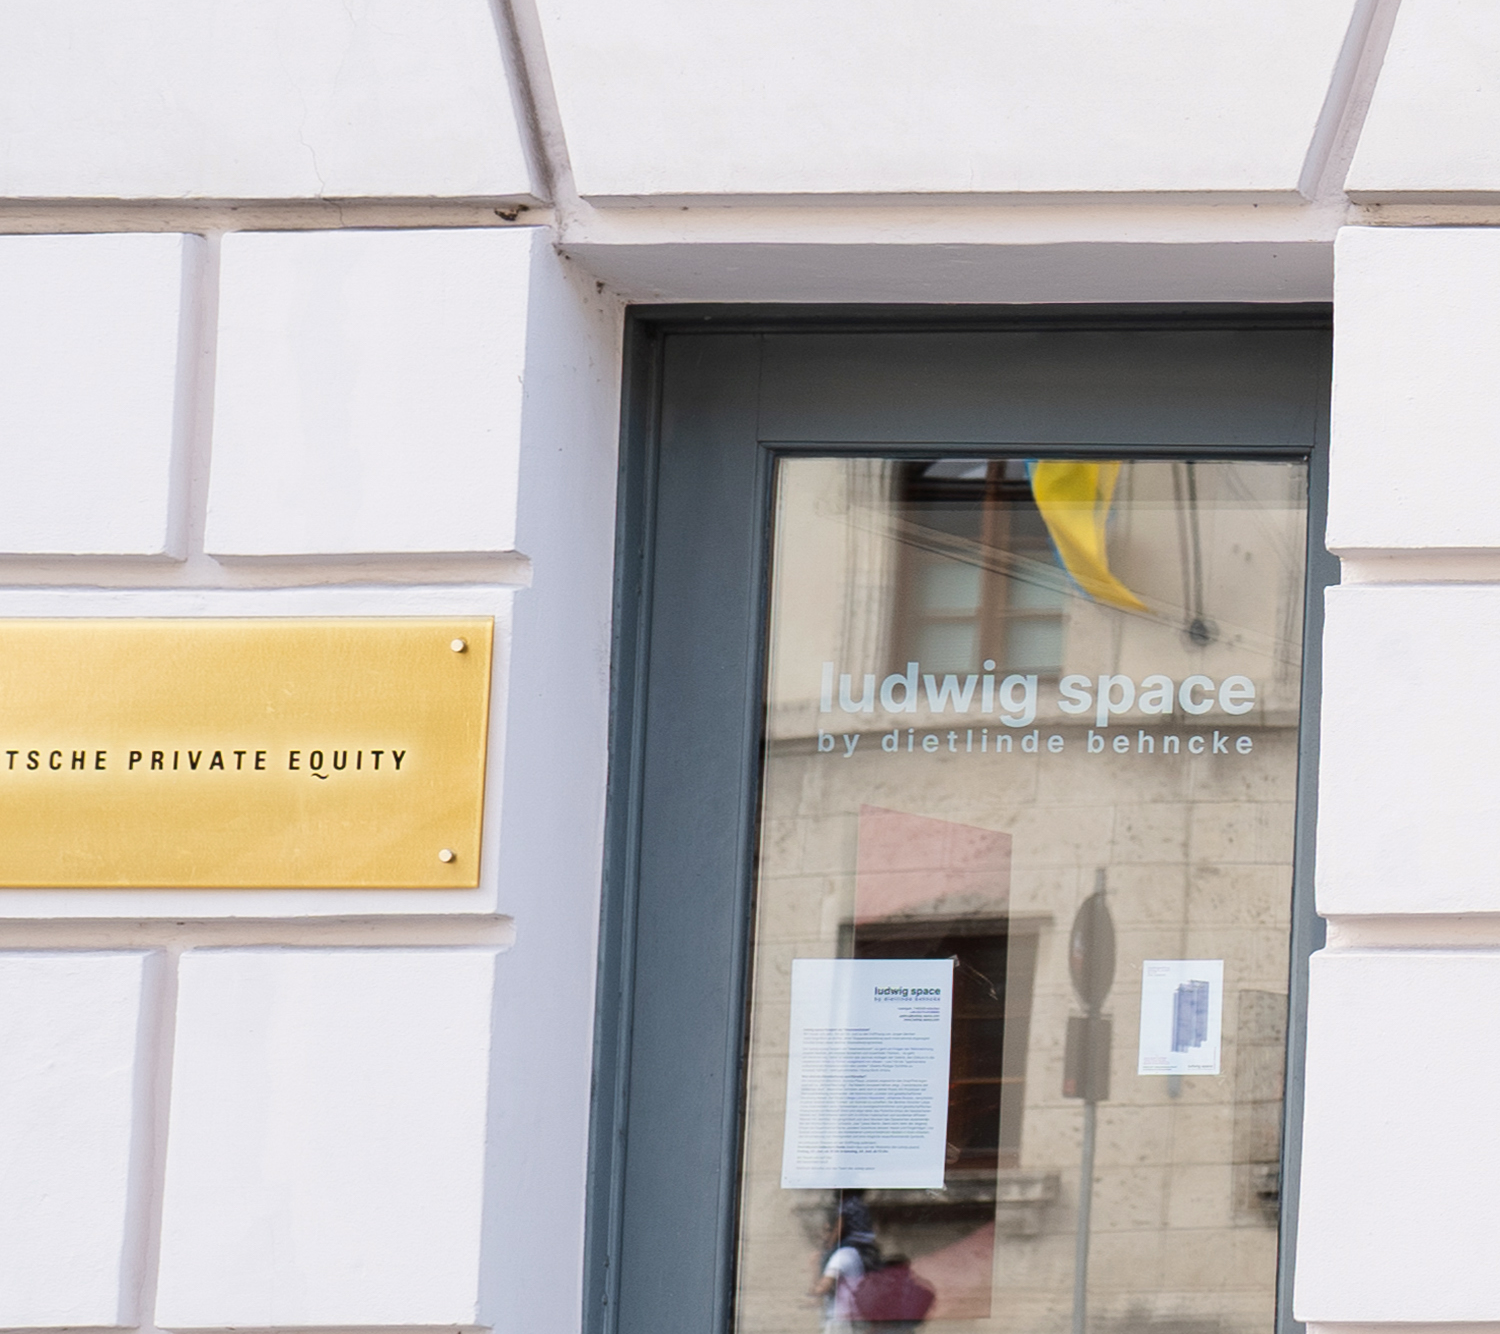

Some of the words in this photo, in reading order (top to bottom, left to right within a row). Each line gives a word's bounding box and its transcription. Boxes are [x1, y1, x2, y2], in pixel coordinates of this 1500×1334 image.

[819, 659, 1039, 728] ludwig
[1057, 673, 1256, 728] space
[816, 729, 861, 758] by
[881, 728, 1066, 754] dietlinde
[1087, 729, 1255, 755] behncke
[128, 750, 268, 771] PRIVATE
[288, 750, 408, 780] EQUITY
